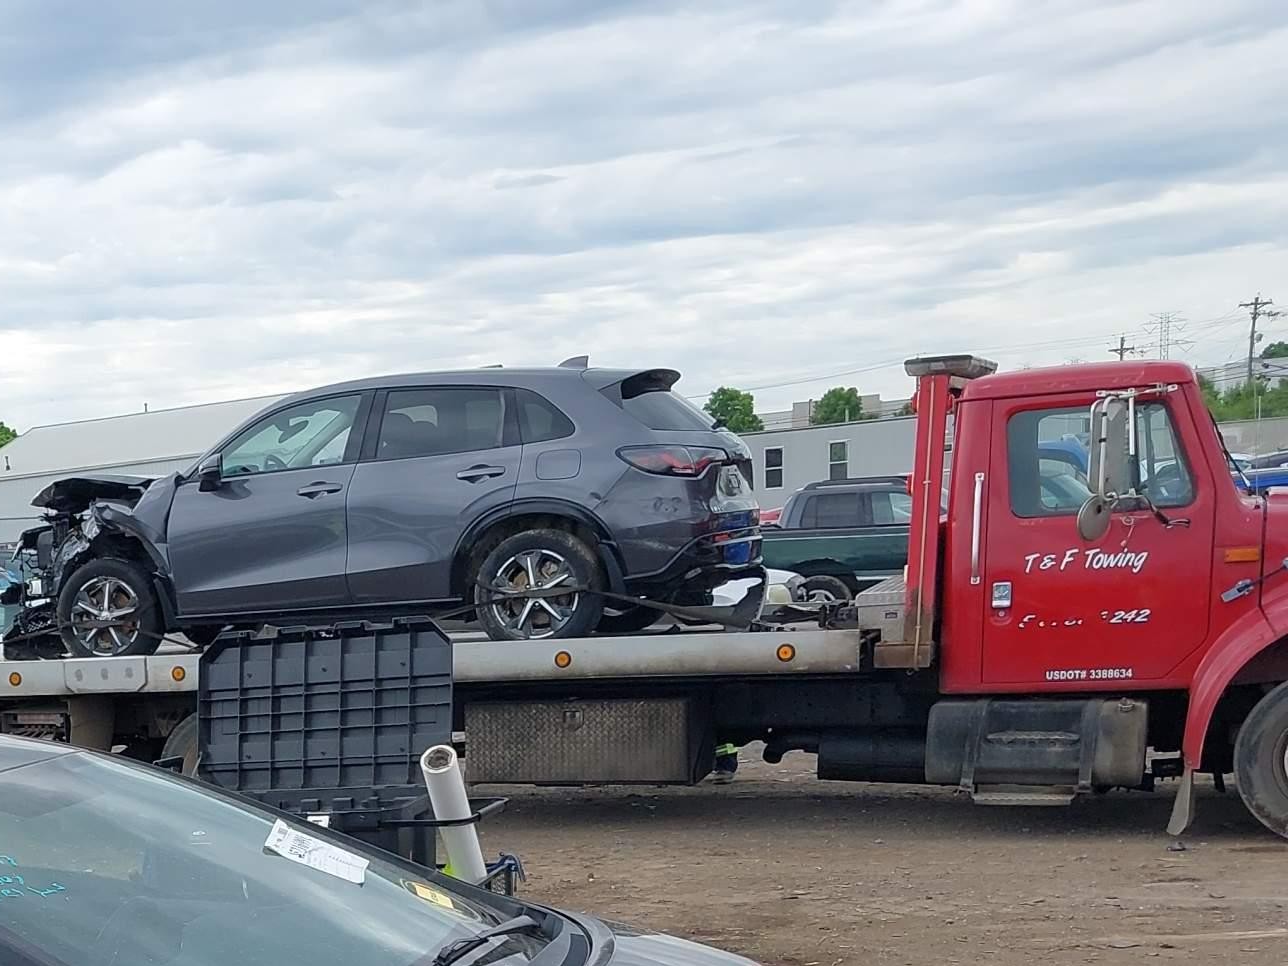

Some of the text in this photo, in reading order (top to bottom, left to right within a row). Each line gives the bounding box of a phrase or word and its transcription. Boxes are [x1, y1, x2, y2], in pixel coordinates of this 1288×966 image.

[1024, 548, 1149, 573] T & F Towing
[1045, 668, 1133, 681] USDOT# 3388634
